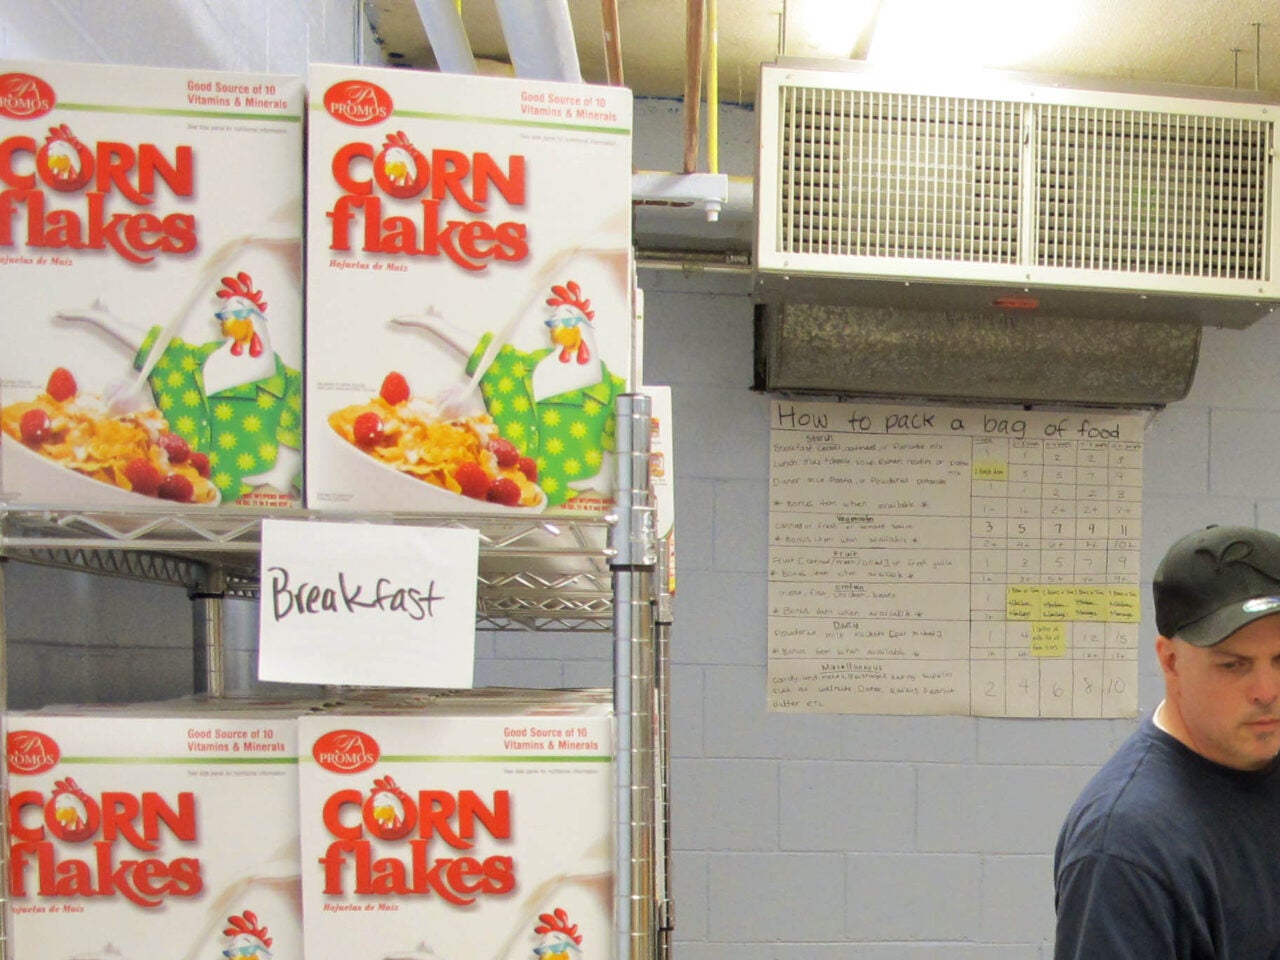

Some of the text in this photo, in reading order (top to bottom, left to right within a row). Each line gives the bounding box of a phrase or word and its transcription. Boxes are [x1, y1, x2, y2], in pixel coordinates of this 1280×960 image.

[187, 80, 276, 95] Good Source of 10
[521, 91, 606, 108] Good Source of 10
[187, 94, 287, 110] Vitamins & Minerals
[331, 101, 387, 118] PROMOS
[521, 104, 617, 122] Vitamins & Minerals
[0, 126, 193, 205] CORN
[331, 131, 525, 213] CORN
[0, 189, 199, 264] flakes
[326, 194, 529, 271] flakes
[778, 404, 1120, 440] How to pack a bag of food
[268, 565, 444, 623] Breakfast
[187, 729, 274, 739] Good Source of 10
[504, 727, 587, 738] Good Source of 10
[504, 739, 599, 751] Vitamins & Minerals
[187, 741, 286, 752] Vitamins & Minerals
[319, 752, 374, 765] PROMOS
[8, 777, 196, 851] CORN
[323, 776, 511, 850] CORN
[10, 840, 204, 907] flakes
[318, 839, 516, 907] flakes
